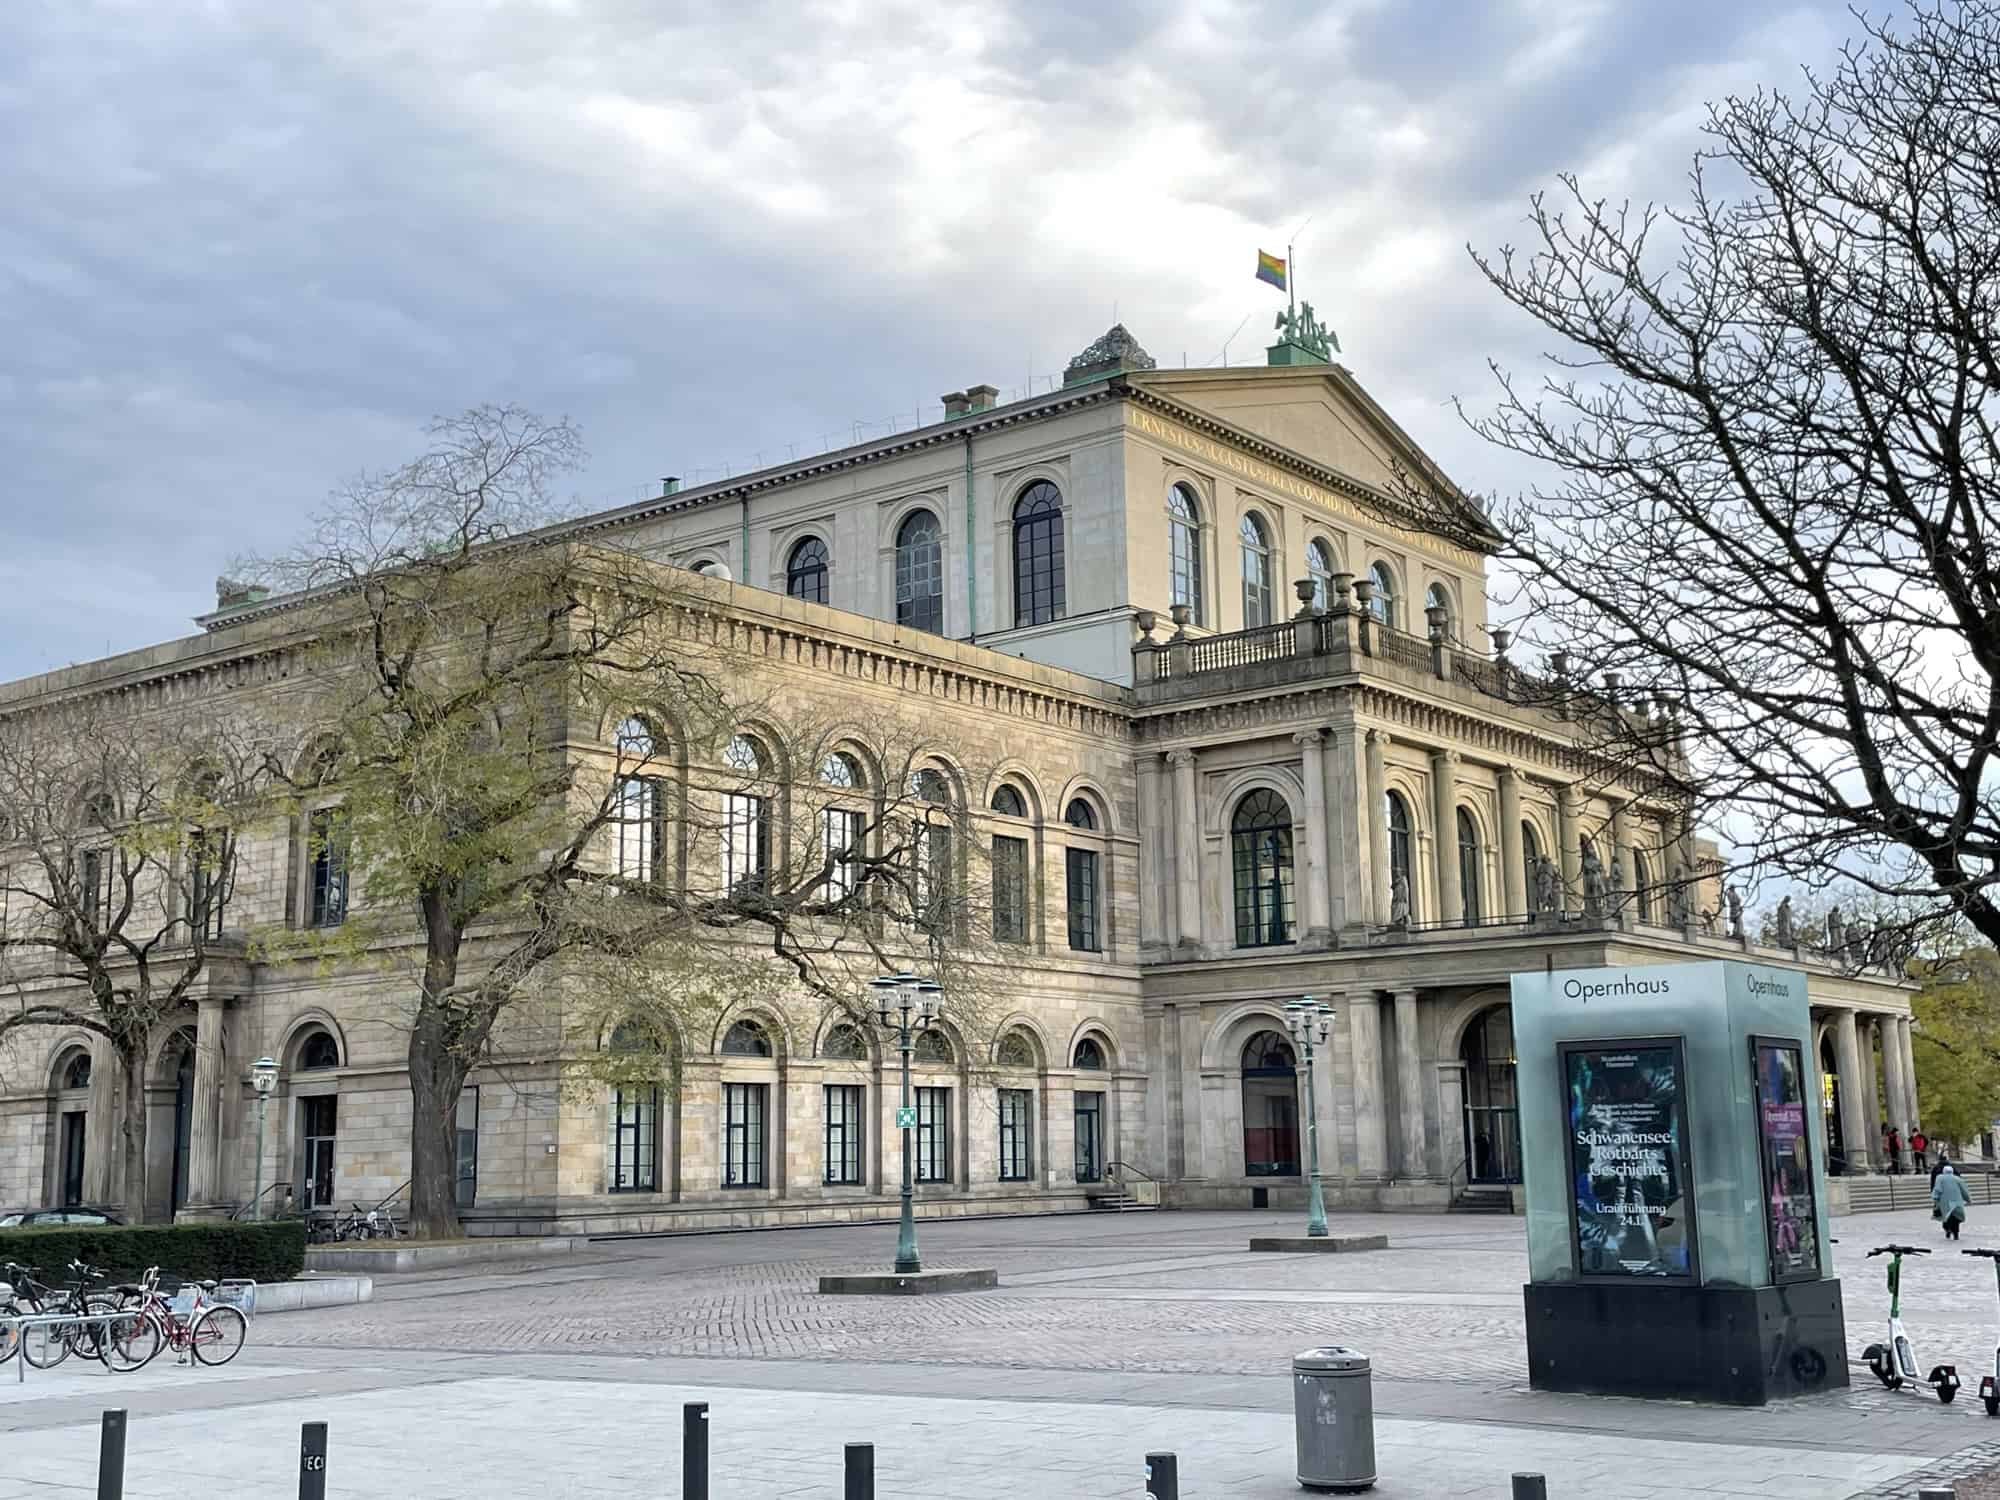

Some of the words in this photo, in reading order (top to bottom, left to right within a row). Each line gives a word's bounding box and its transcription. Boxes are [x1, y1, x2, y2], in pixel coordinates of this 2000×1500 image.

[1564, 974, 1669, 1003] Opernhaus
[1747, 973, 1789, 999] Opernhaus
[1597, 1147, 1657, 1161] Rotbarts
[1590, 1162, 1667, 1177] Geschichte
